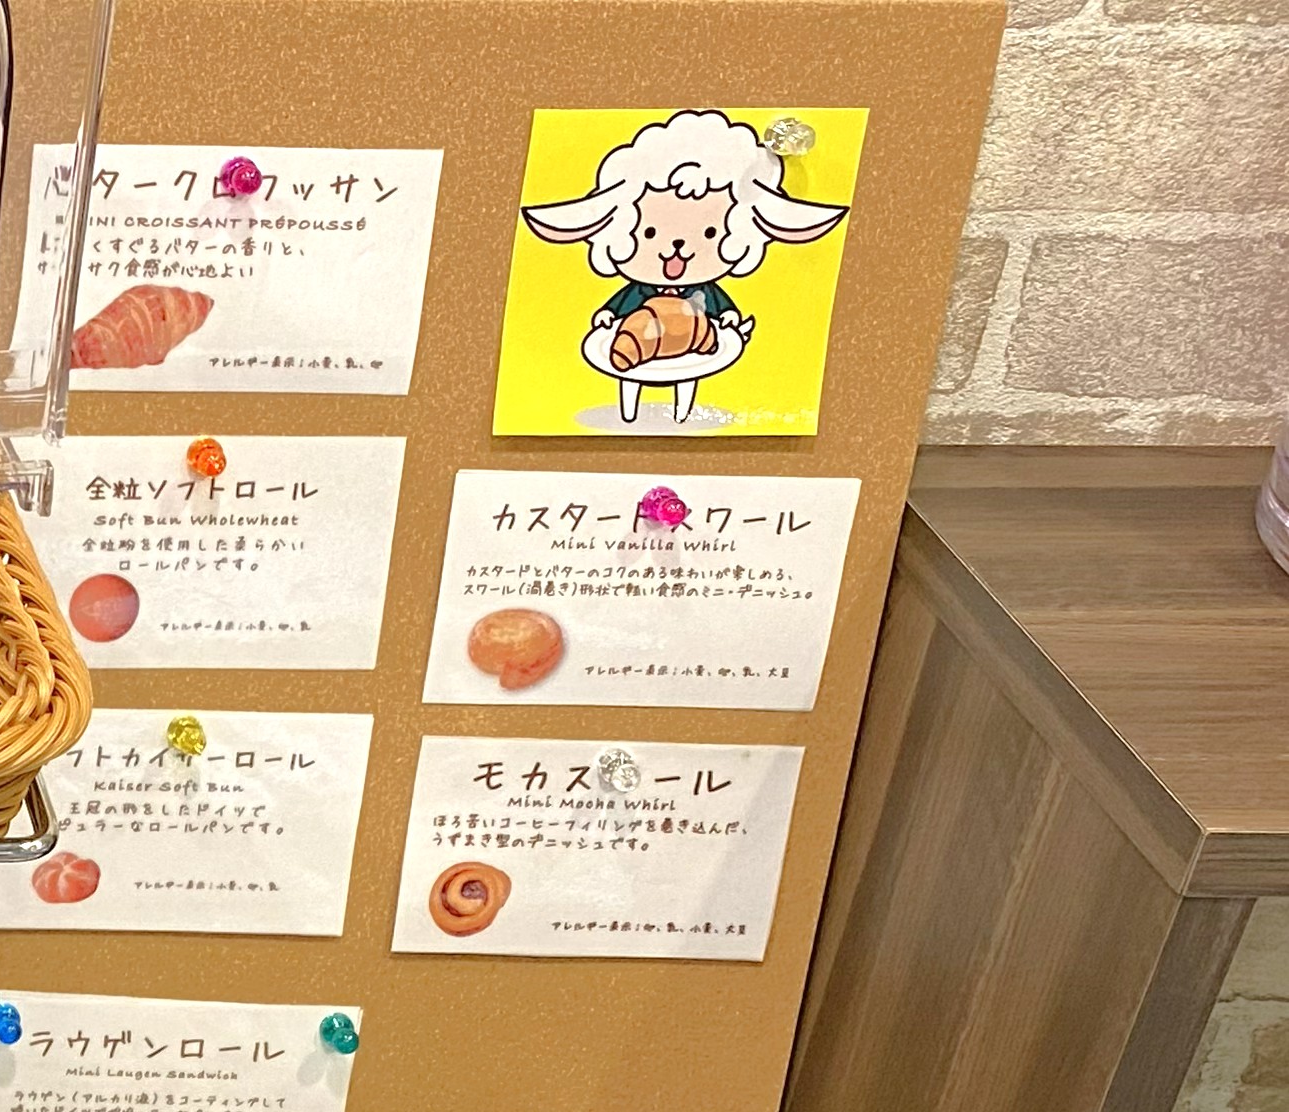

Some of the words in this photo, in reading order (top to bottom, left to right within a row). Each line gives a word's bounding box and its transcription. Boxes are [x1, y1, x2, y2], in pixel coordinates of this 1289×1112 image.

[124, 216, 242, 230] CROISSANT
[41, 236, 307, 258] くすぐるバターの香りと、
[37, 258, 254, 280] ササク食感が心地よい
[85, 475, 319, 502] 全粒ソフトロール
[93, 514, 135, 529] Soft
[143, 515, 182, 527] Bun
[190, 514, 300, 527] Wholewheat
[81, 537, 305, 553] 全粒粉を使用した柔らかい
[550, 537, 597, 551] Mini
[603, 536, 675, 552] Vanilla
[682, 538, 737, 552] Whirl
[118, 558, 260, 573] ロールパンです。
[64, 745, 317, 772] フトカイーロール
[473, 761, 733, 797] モカスール
[93, 780, 154, 793] Kaiser
[158, 781, 200, 797] Soft
[206, 781, 245, 793] Bun
[69, 802, 266, 817] 王冠の形をしたドイツで
[507, 796, 553, 810] Mini
[624, 798, 677, 812] Whirl
[58, 817, 285, 836] ピュラーなロールパンです。
[431, 832, 650, 854] うずまき型のデニッシュです。
[29, 1030, 286, 1063] ラウゲンロール
[65, 1066, 101, 1078] Mini
